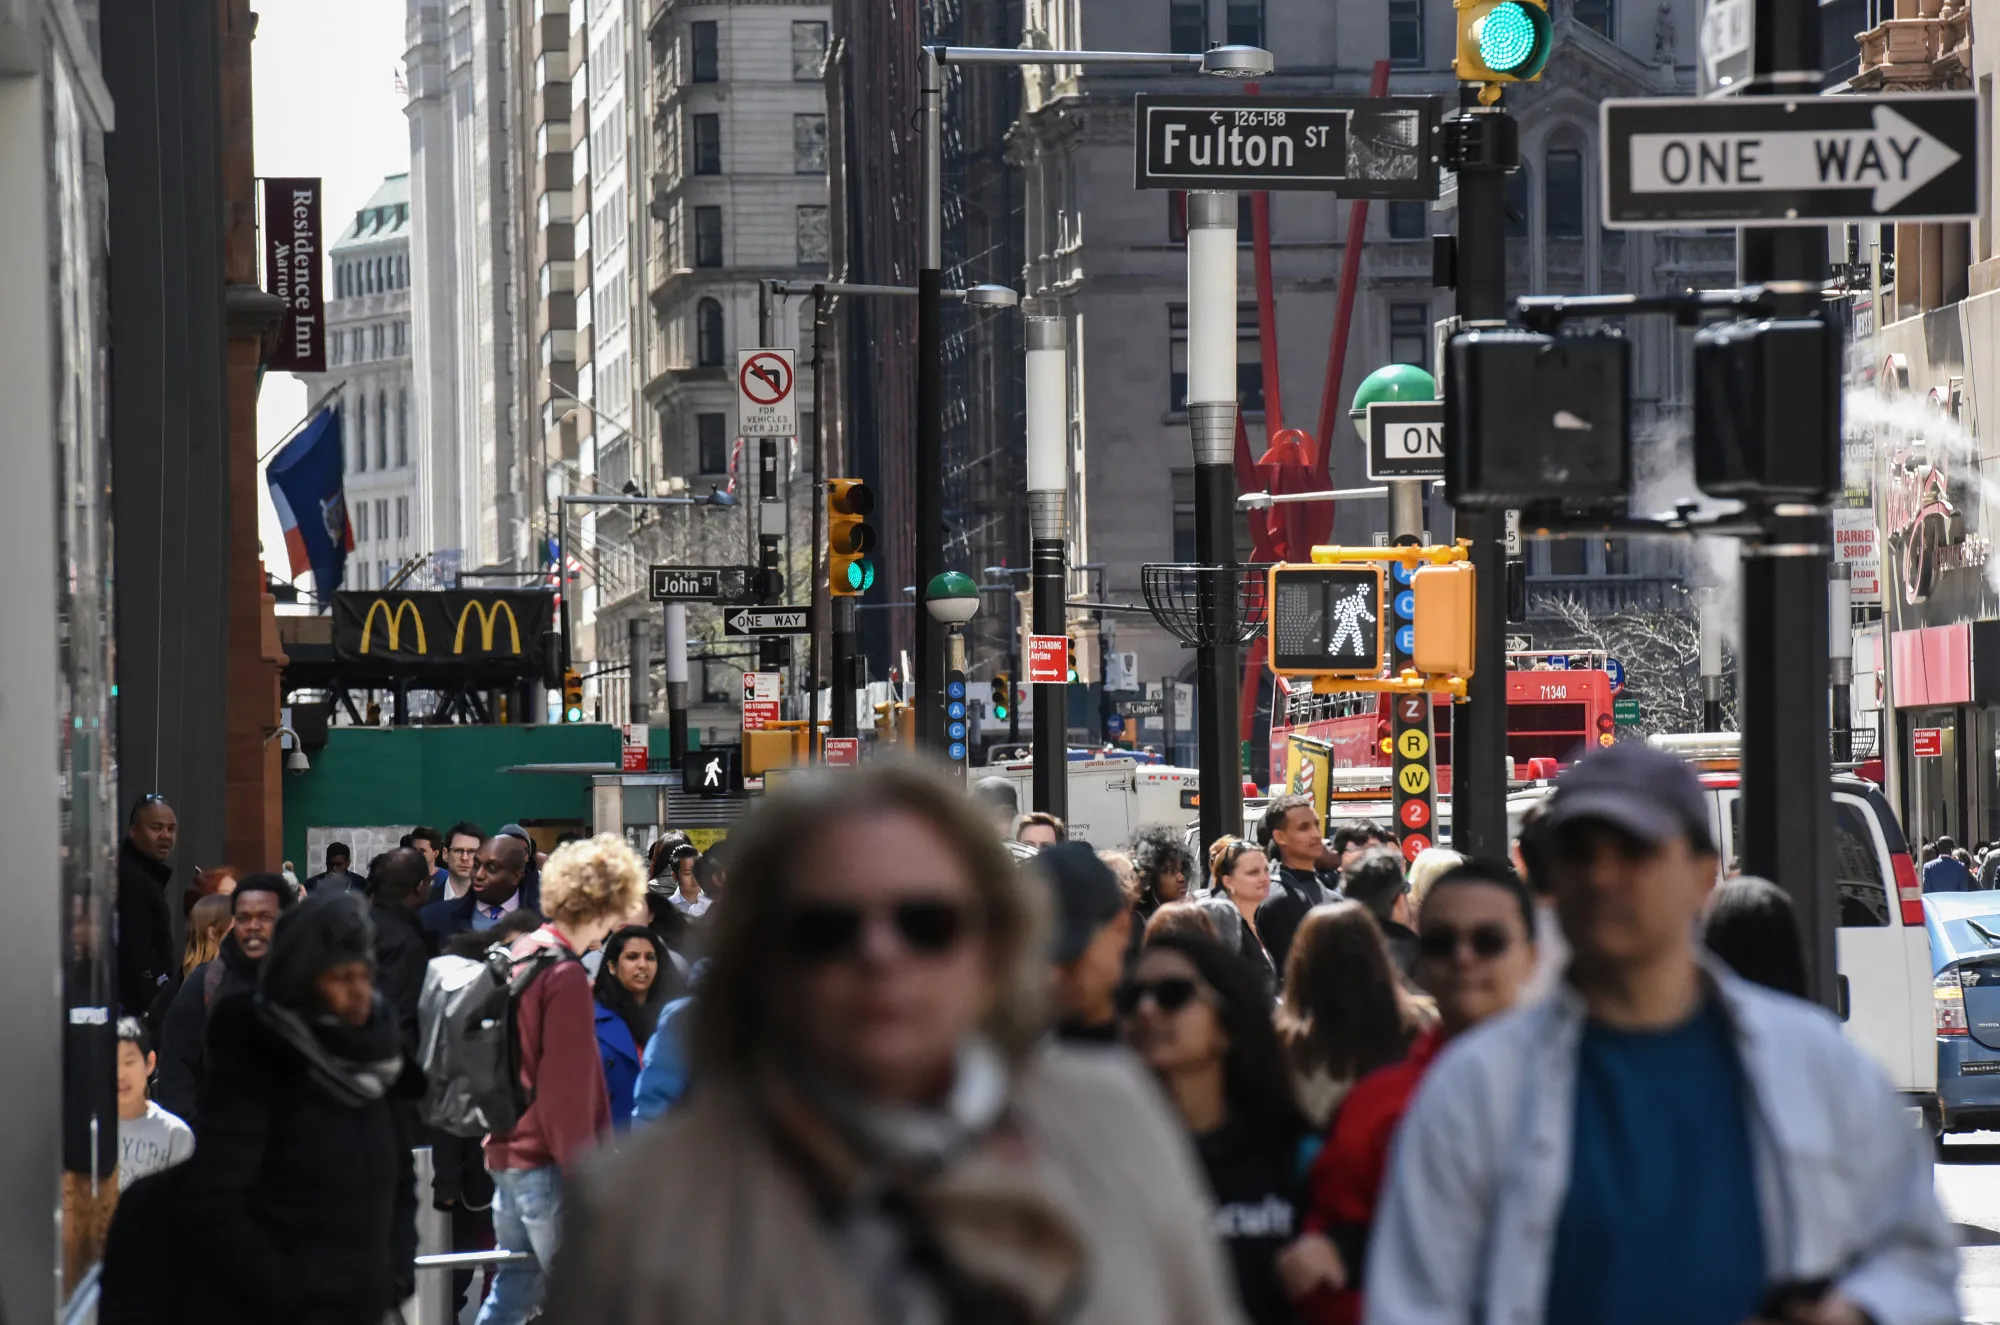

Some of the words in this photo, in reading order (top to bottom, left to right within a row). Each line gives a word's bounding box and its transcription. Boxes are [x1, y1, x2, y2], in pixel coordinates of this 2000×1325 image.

[1234, 111, 1286, 127] 126-158
[1164, 123, 1294, 167] Fulton
[1305, 126, 1329, 148] ST
[1661, 140, 1763, 185] ONE
[1814, 137, 1921, 183] WAY
[293, 190, 314, 309] Residence
[296, 315, 316, 358] Inn
[1404, 427, 1444, 454] ON
[1843, 443, 1873, 459] TORE
[1844, 545, 1872, 558] SHOP
[1853, 570, 1876, 578] FLOOR
[660, 576, 699, 593] John
[702, 577, 713, 586] ST
[738, 615, 762, 627] ONE
[774, 614, 801, 626] WAY
[1030, 641, 1038, 650] NO
[1038, 641, 1062, 650] STANDING
[1031, 651, 1051, 661] Anytime
[1540, 685, 1567, 699] 71340
[952, 705, 961, 715] A
[1131, 703, 1159, 715] Liberty
[1406, 700, 1420, 717] Z
[952, 725, 961, 736] C
[953, 746, 961, 756] E
[1407, 736, 1420, 751] R
[1084, 759, 1122, 768] garda.com
[954, 766, 961, 777] J
[1405, 771, 1424, 787] W
[1409, 805, 1422, 822] 2
[1411, 840, 1424, 858] 3
